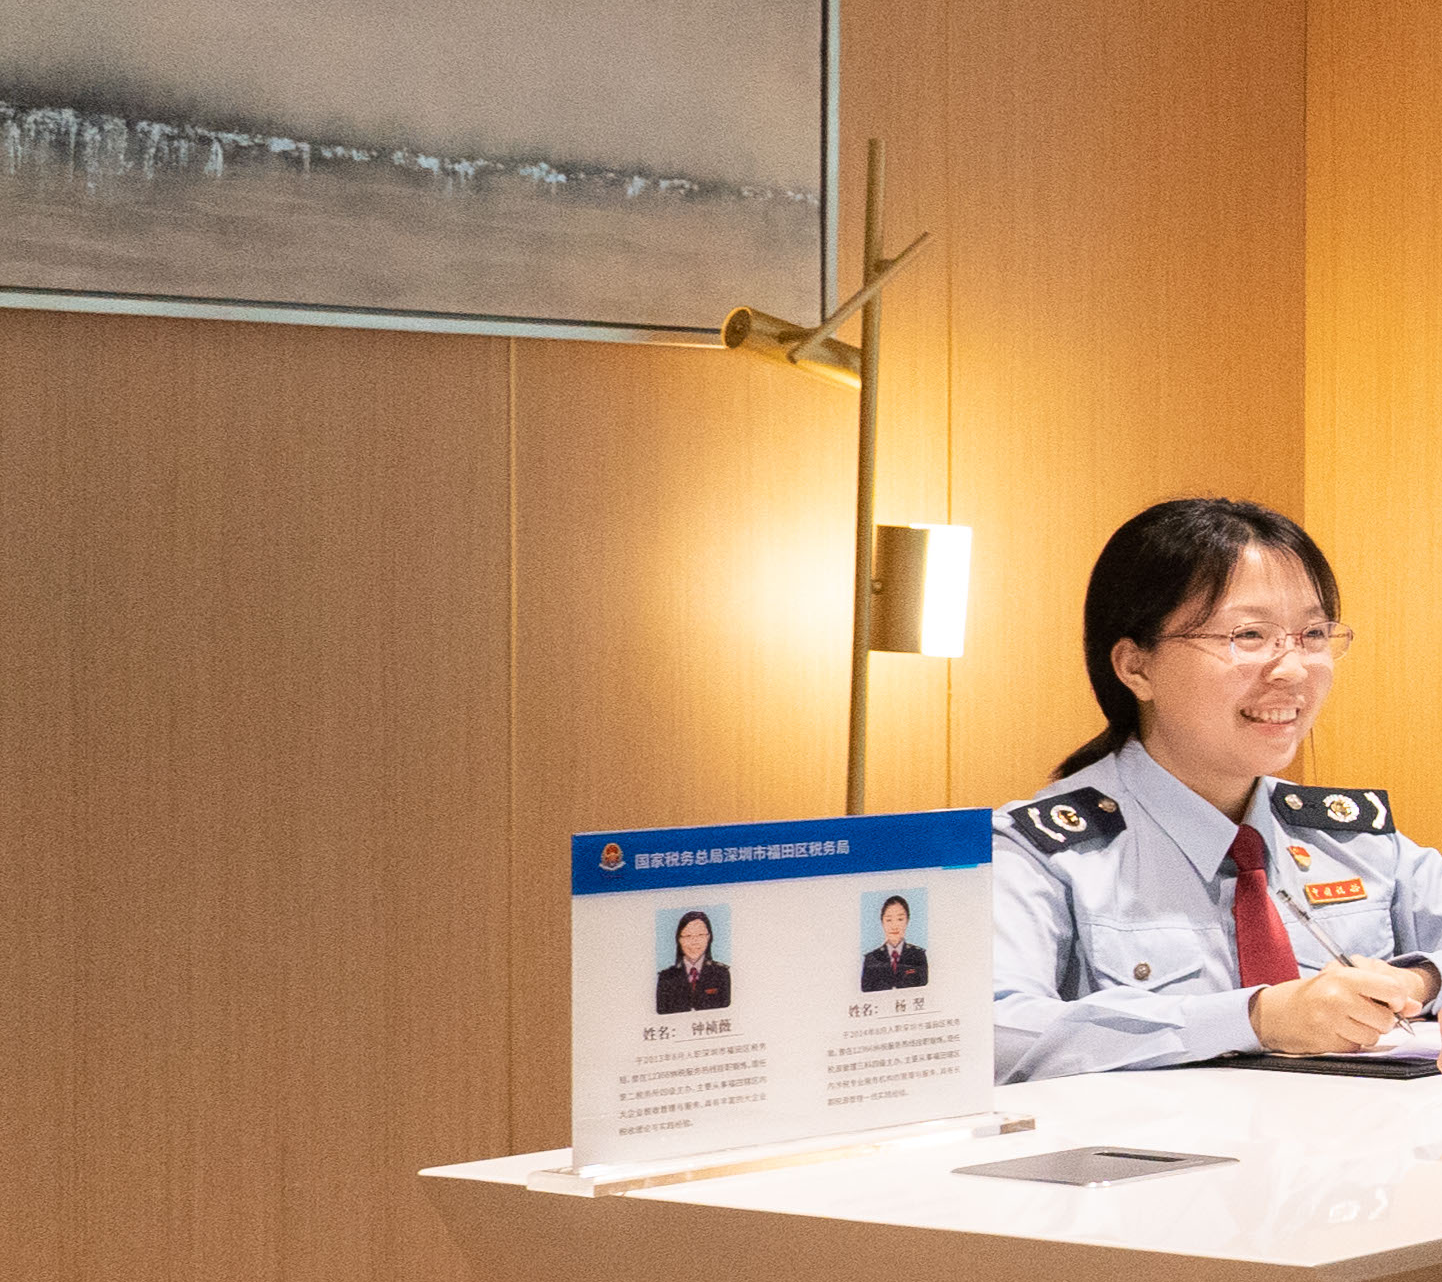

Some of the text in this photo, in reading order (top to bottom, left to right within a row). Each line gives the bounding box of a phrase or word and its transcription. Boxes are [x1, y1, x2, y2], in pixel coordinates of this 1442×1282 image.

[634, 839, 850, 870] 国家税务总局深圳市福田区税务局
